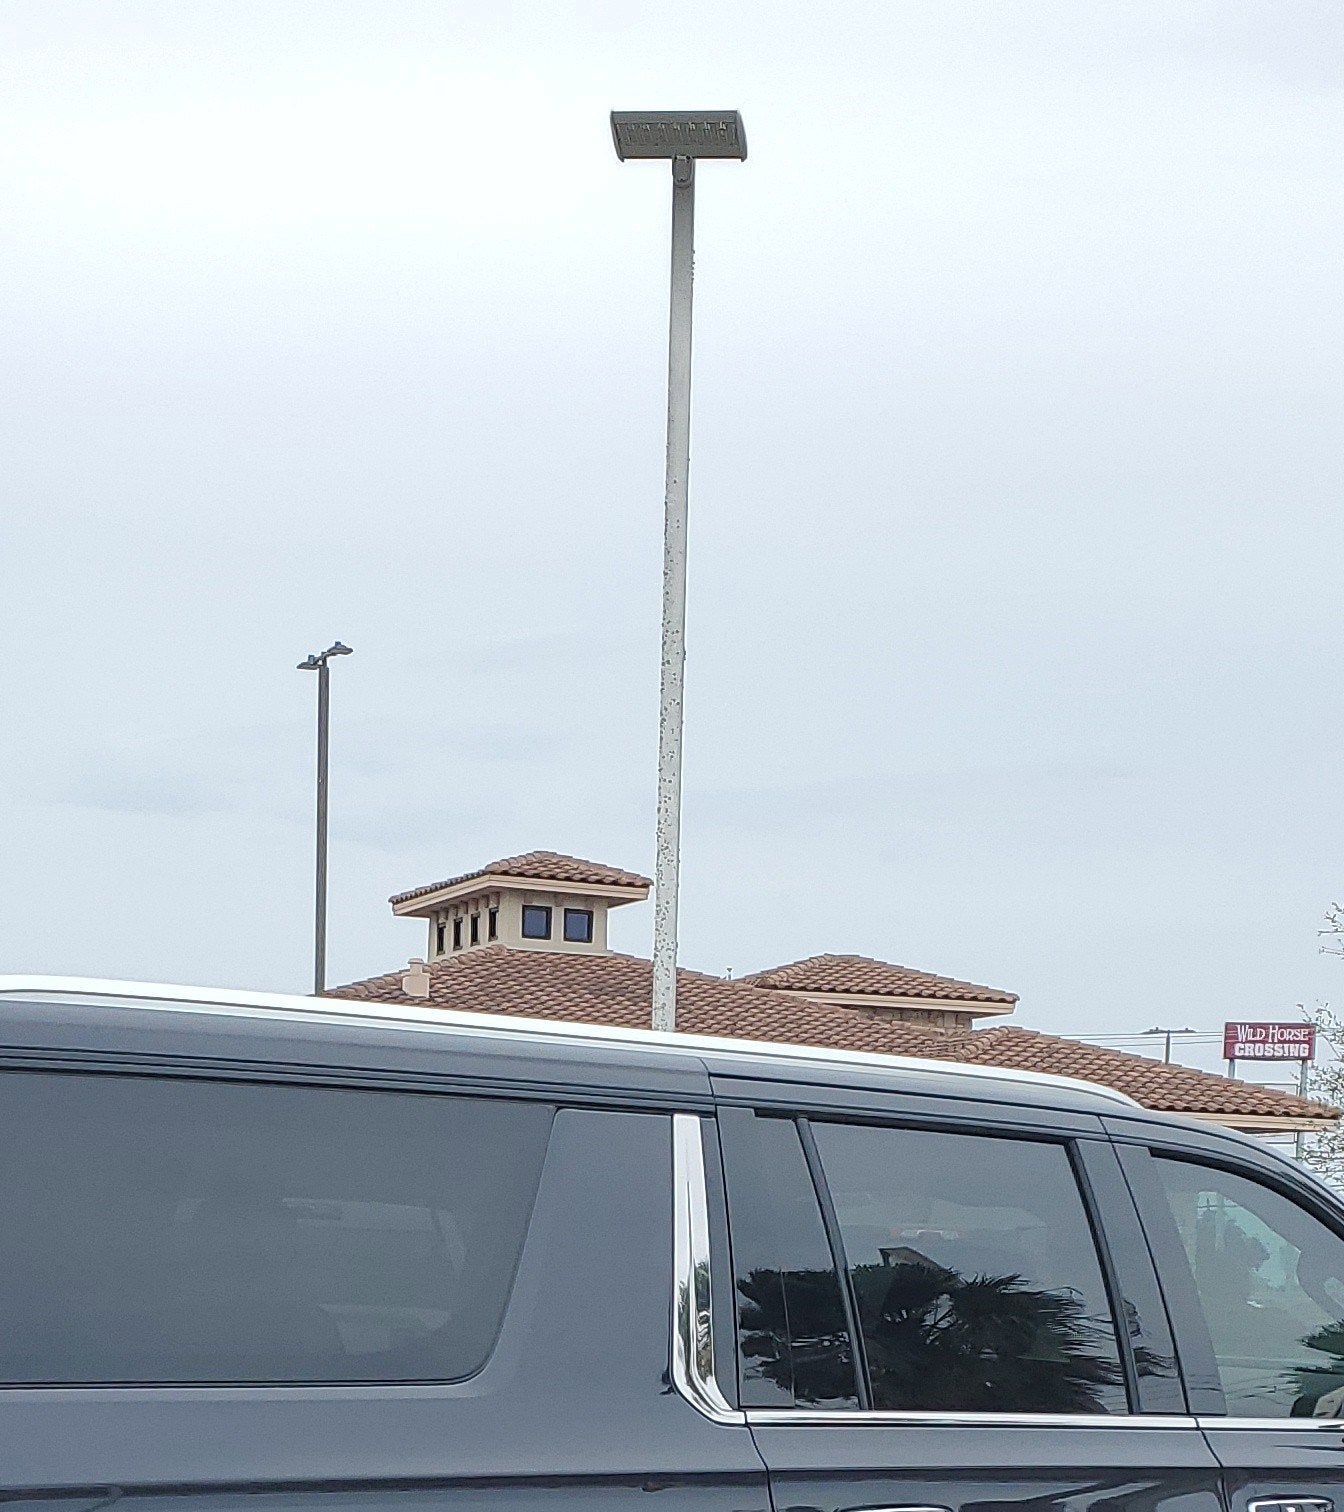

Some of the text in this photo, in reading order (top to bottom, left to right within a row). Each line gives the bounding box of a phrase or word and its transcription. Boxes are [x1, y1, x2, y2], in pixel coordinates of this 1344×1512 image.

[1236, 1024, 1309, 1042] WILD HORSE
[1234, 1043, 1310, 1057] CROSSING
